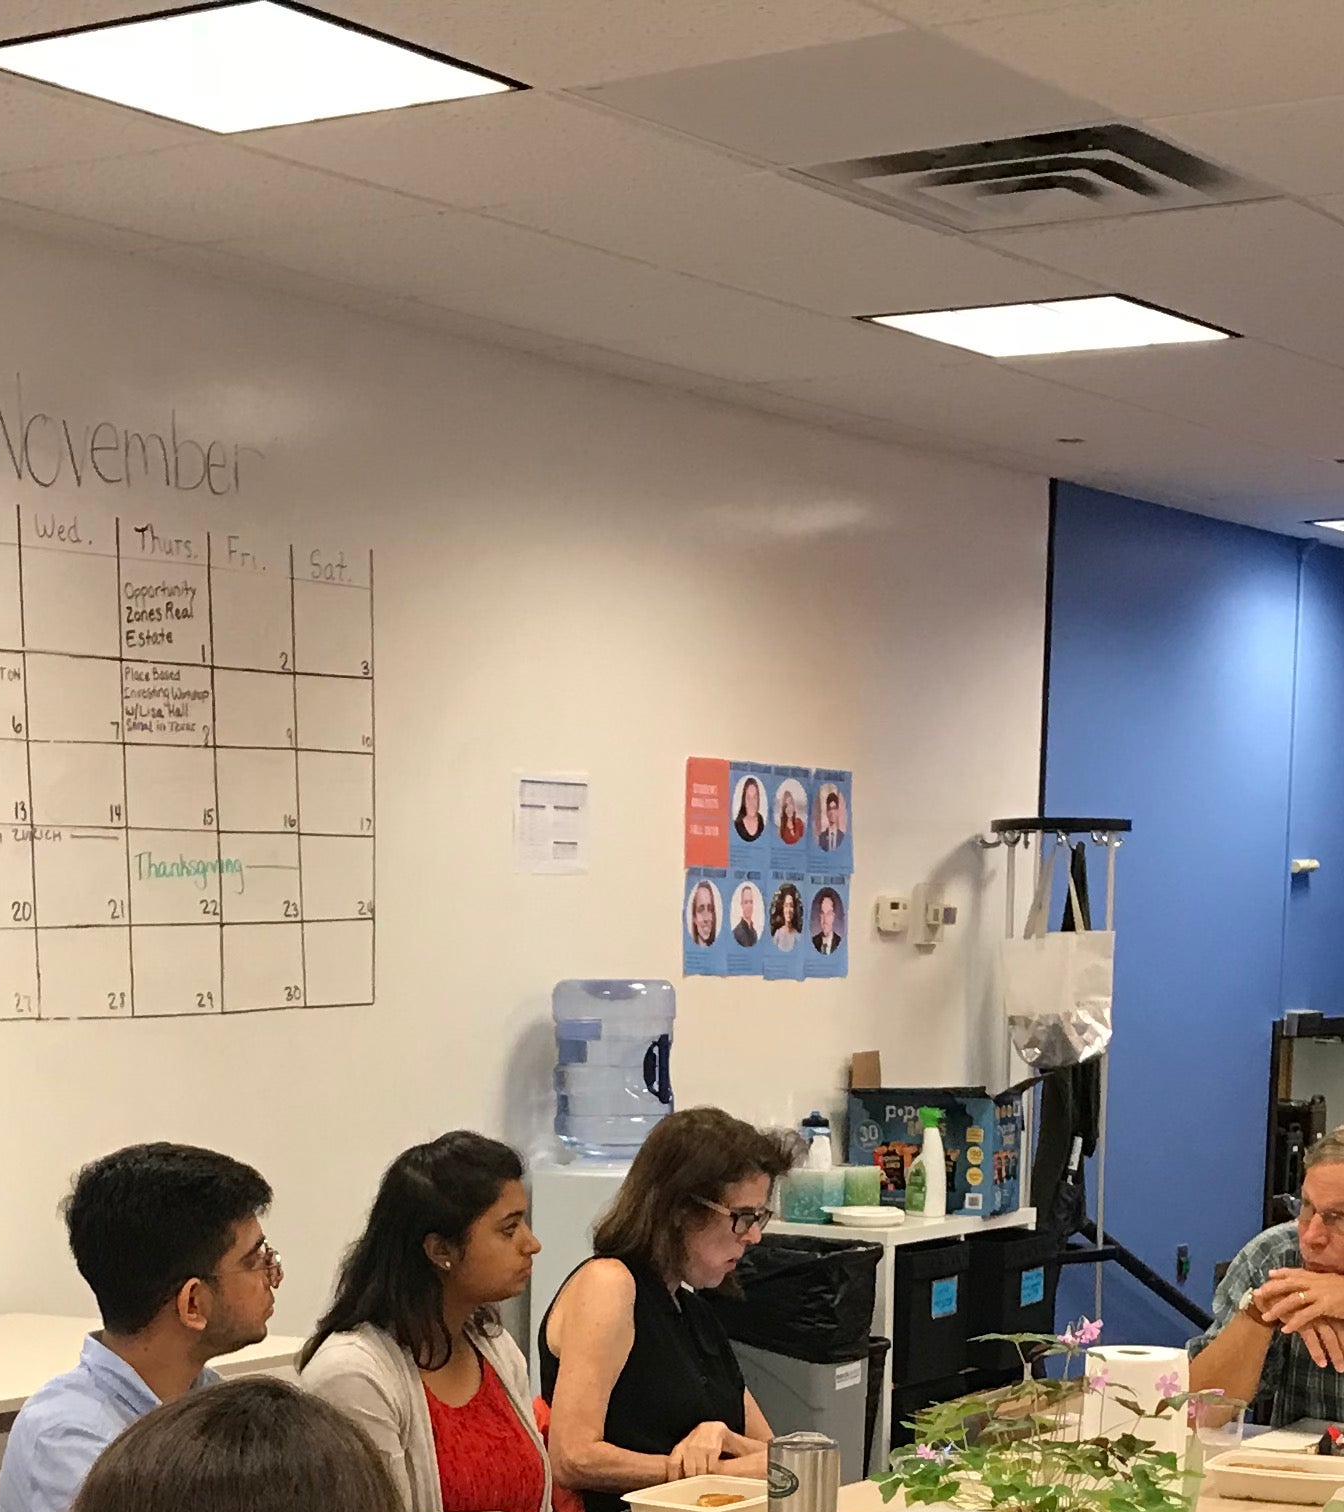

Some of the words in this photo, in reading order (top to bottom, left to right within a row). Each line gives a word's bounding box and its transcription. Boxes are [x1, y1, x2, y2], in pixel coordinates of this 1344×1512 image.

[34, 513, 93, 545] Wed.
[134, 522, 199, 560] Thurs.
[309, 549, 352, 582] Sat.
[124, 580, 197, 601] Opportunity
[126, 605, 162, 624] Zones
[165, 602, 194, 621] Real
[126, 627, 174, 649] Estate
[279, 651, 290, 671] 2
[360, 660, 370, 677] 3
[11, 715, 22, 734] 6
[110, 721, 120, 740] 7
[14, 800, 27, 822] 13
[109, 803, 122, 823] 14
[203, 807, 215, 826] 15
[284, 813, 297, 828] 16
[134, 850, 245, 895] Thanksgiving
[11, 900, 32, 922] 20
[108, 899, 125, 919] 21
[199, 899, 220, 917] 22
[283, 899, 300, 918] 23
[357, 900, 375, 917] 24
[14, 992, 32, 1012] 27
[196, 992, 215, 1009] 29
[284, 985, 302, 1002] 30
